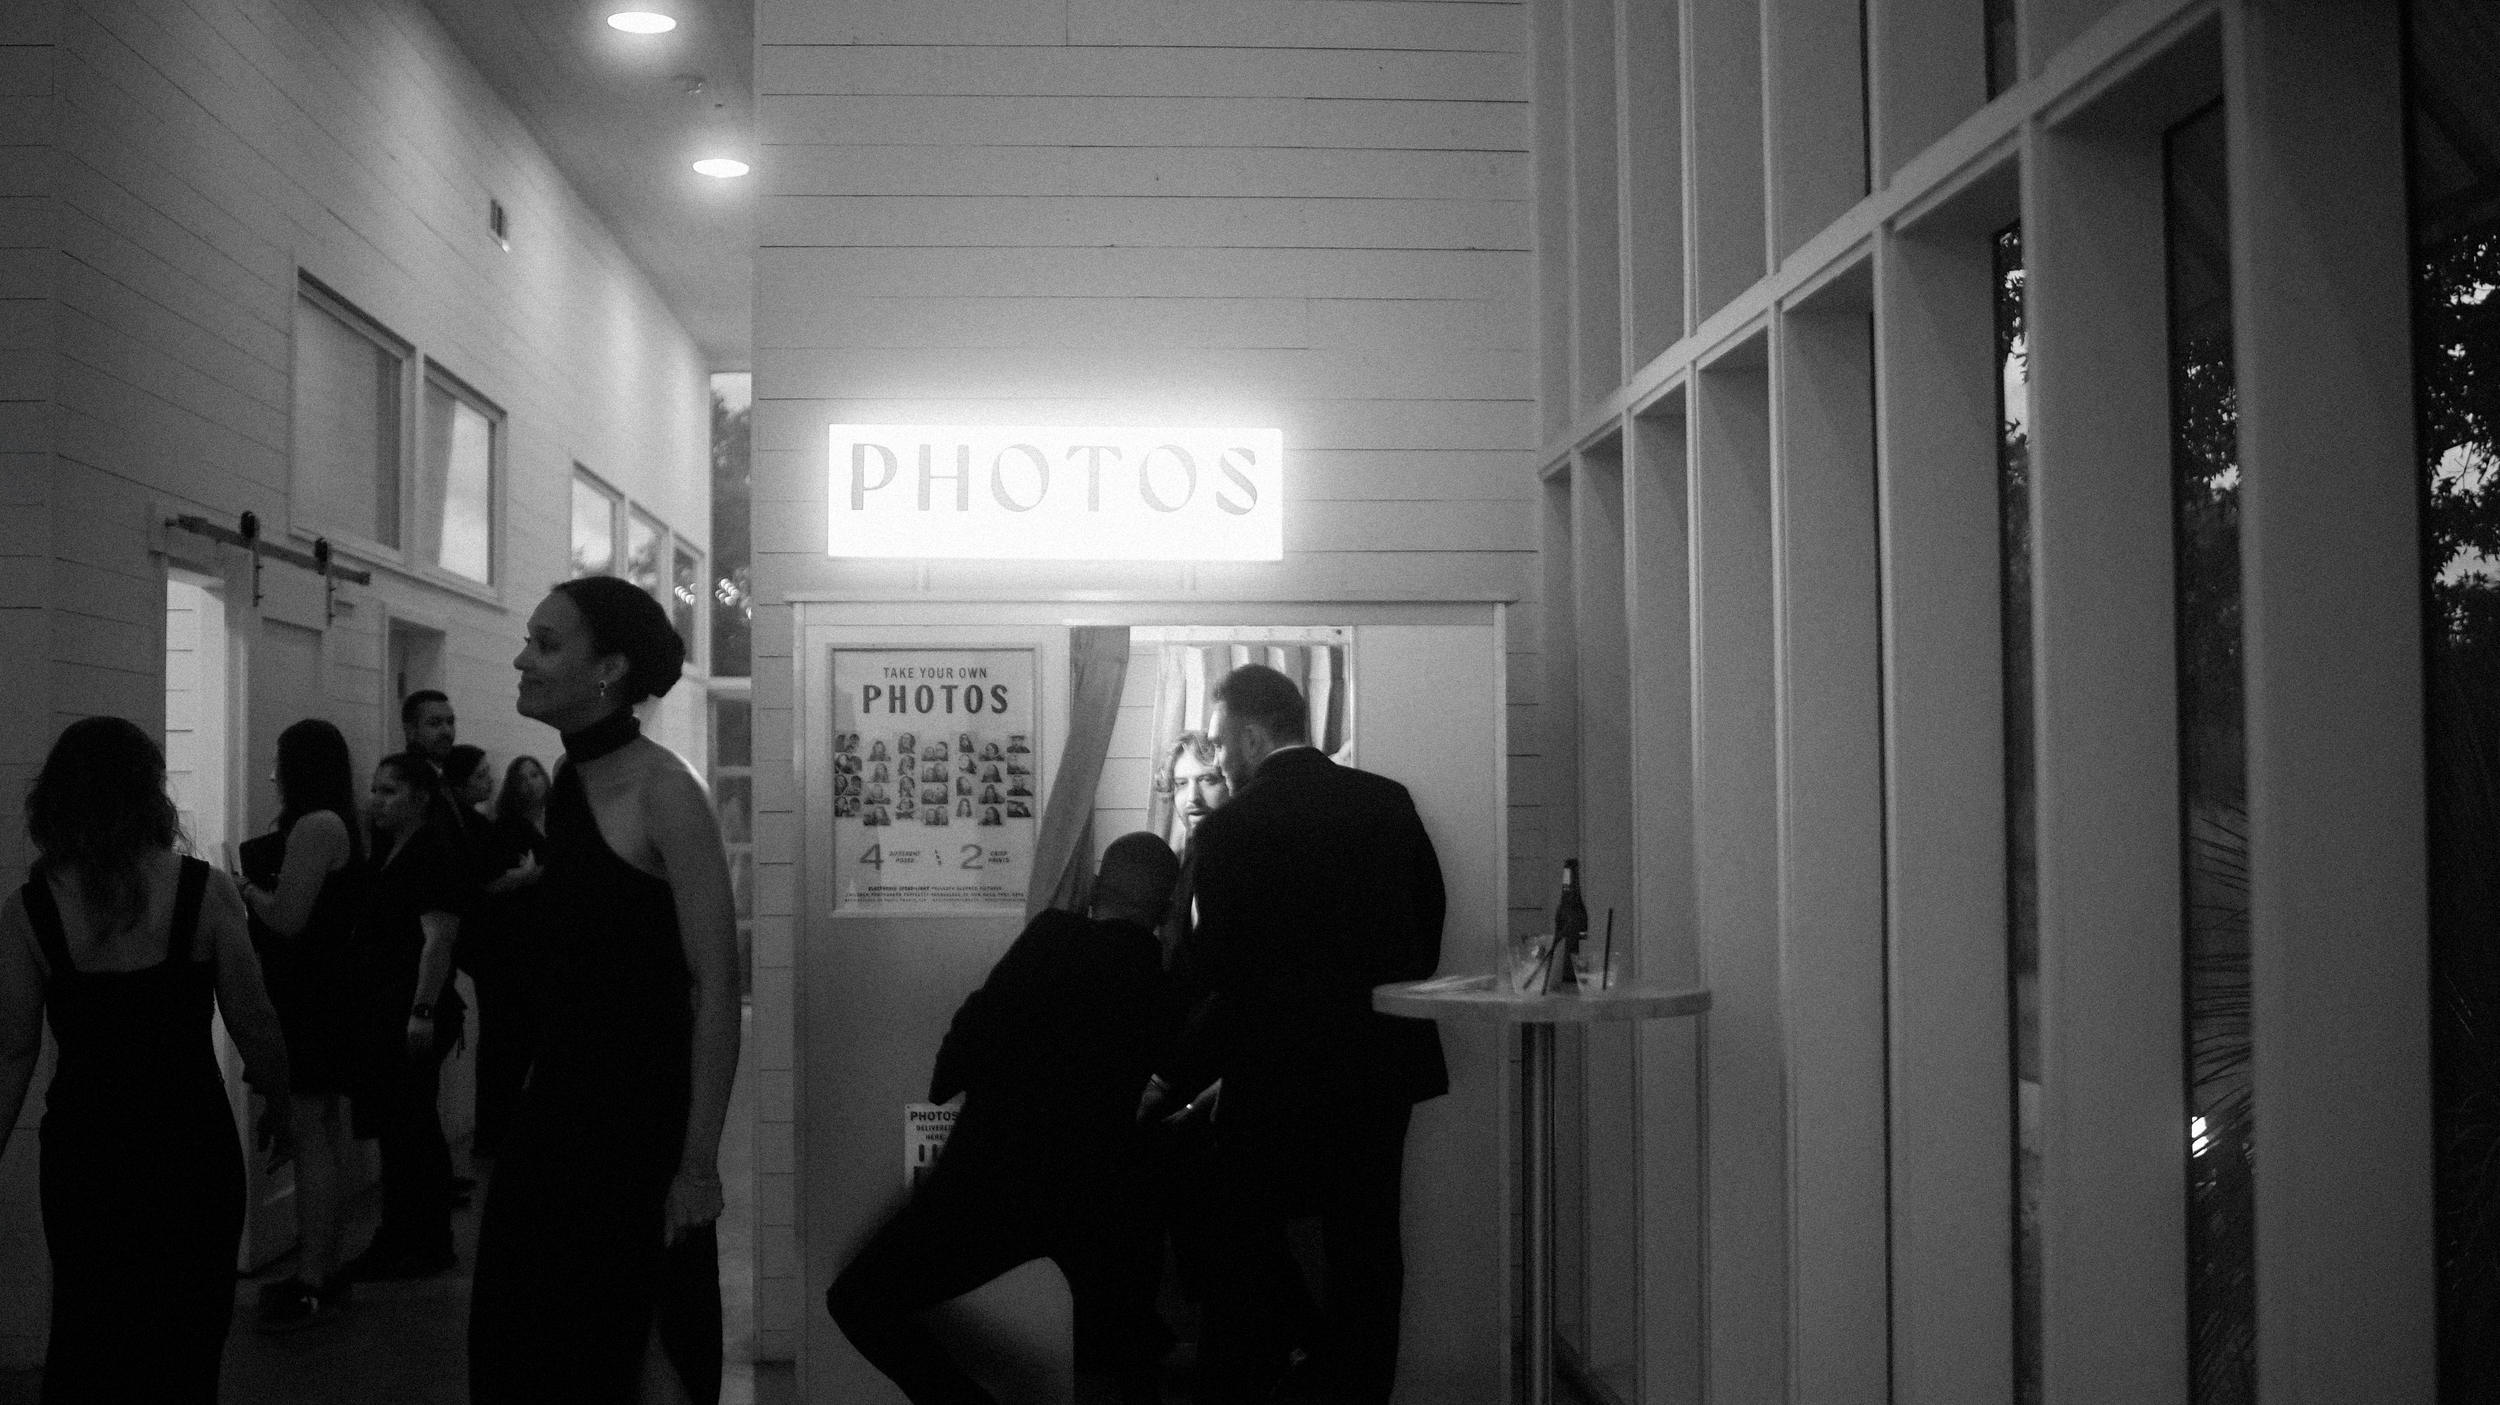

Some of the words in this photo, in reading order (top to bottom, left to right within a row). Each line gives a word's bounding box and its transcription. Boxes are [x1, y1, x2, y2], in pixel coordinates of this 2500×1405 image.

[851, 443, 1258, 516] PHOTOS
[884, 667, 915, 679] TAKE
[919, 667, 953, 679] YOUR
[958, 667, 987, 679] OWN
[862, 684, 1008, 714] PHOTOS
[859, 843, 884, 870] 4
[960, 843, 983, 869] 2
[910, 1111, 959, 1121] PHOTOS
